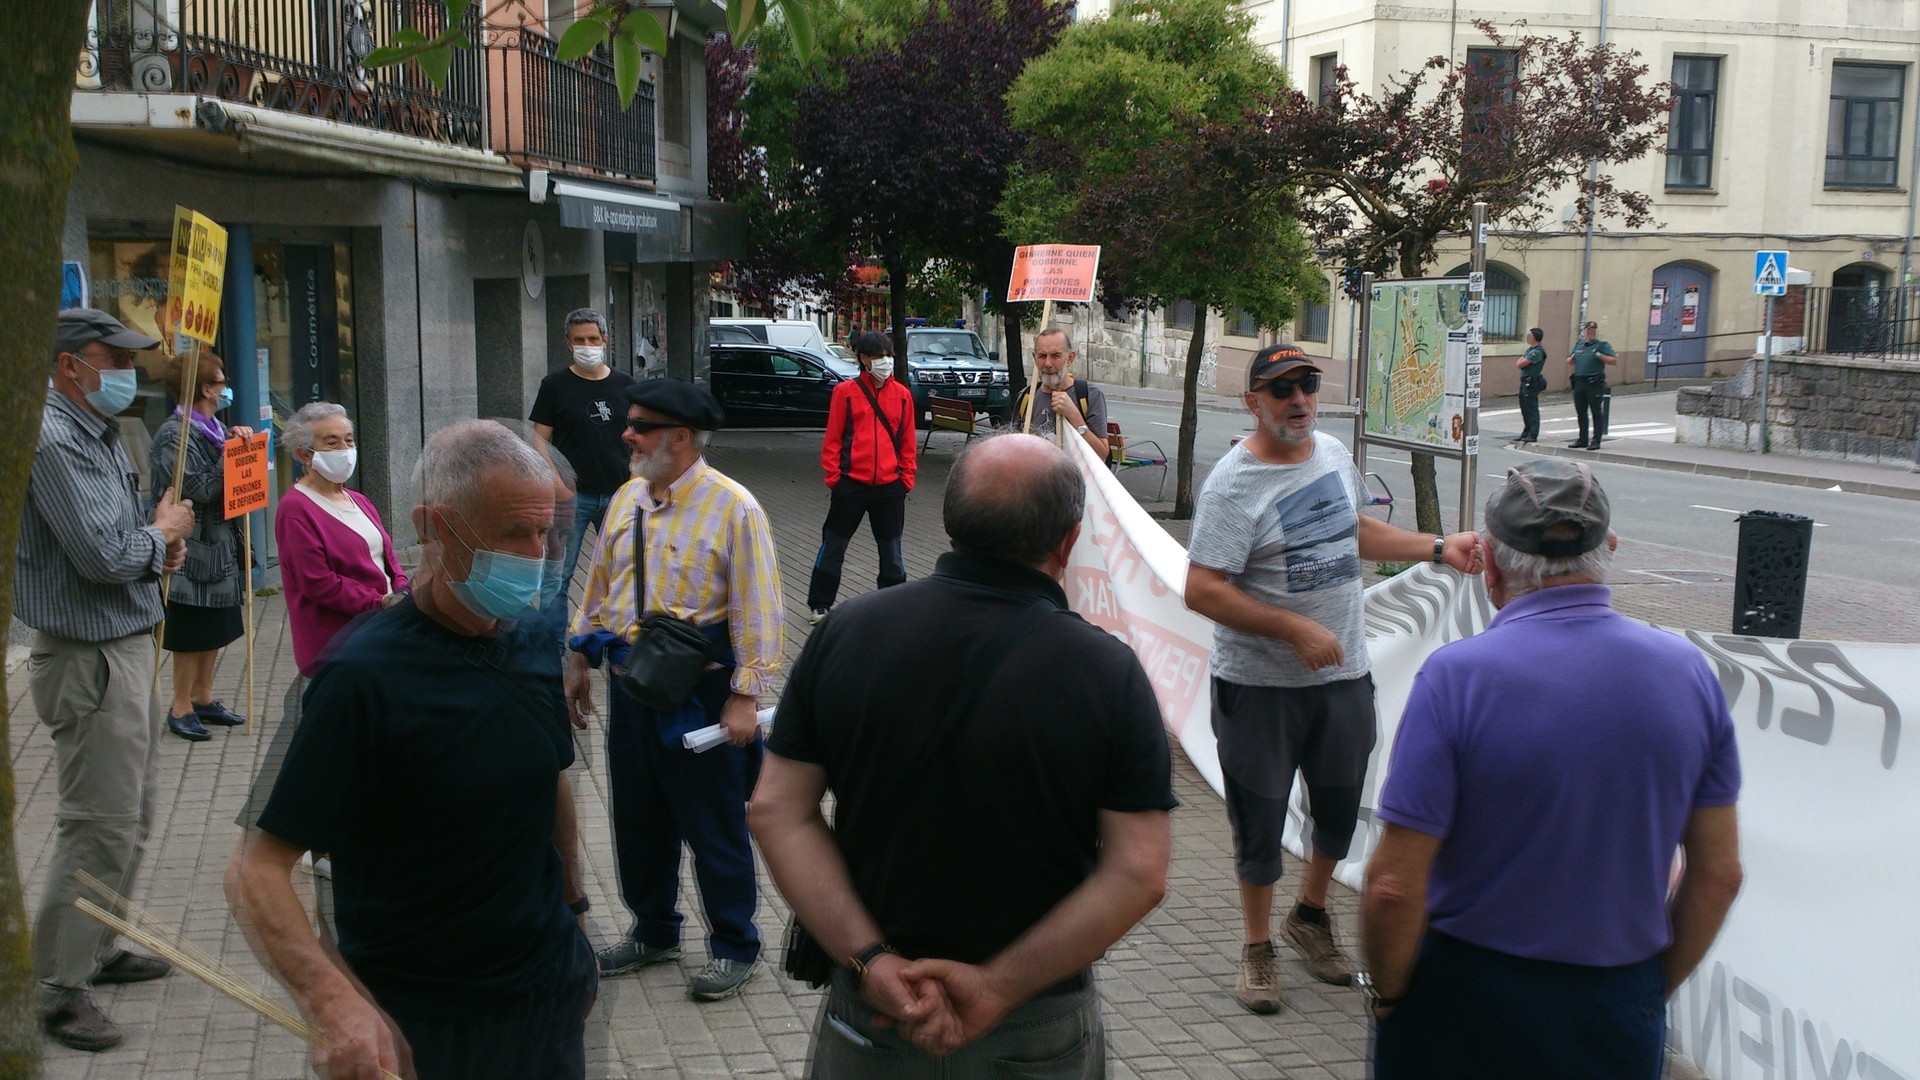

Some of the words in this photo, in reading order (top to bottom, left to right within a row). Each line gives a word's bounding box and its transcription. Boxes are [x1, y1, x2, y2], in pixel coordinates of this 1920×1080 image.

[1019, 250, 1063, 258] GOBIERNE
[1066, 250, 1095, 258] QUIEN
[1032, 258, 1078, 266] GOBIERNE
[1023, 278, 1080, 286] PENSIONES
[1029, 286, 1087, 295] DEFIENDEN
[227, 444, 249, 458] GOBIERNE
[250, 440, 266, 452] QUIEN
[235, 453, 258, 468] GOBIERNE
[241, 468, 252, 479] LAS
[232, 479, 262, 497] PENSIONES
[228, 499, 236, 511] SE
[237, 490, 266, 508] DEFIENDEN
